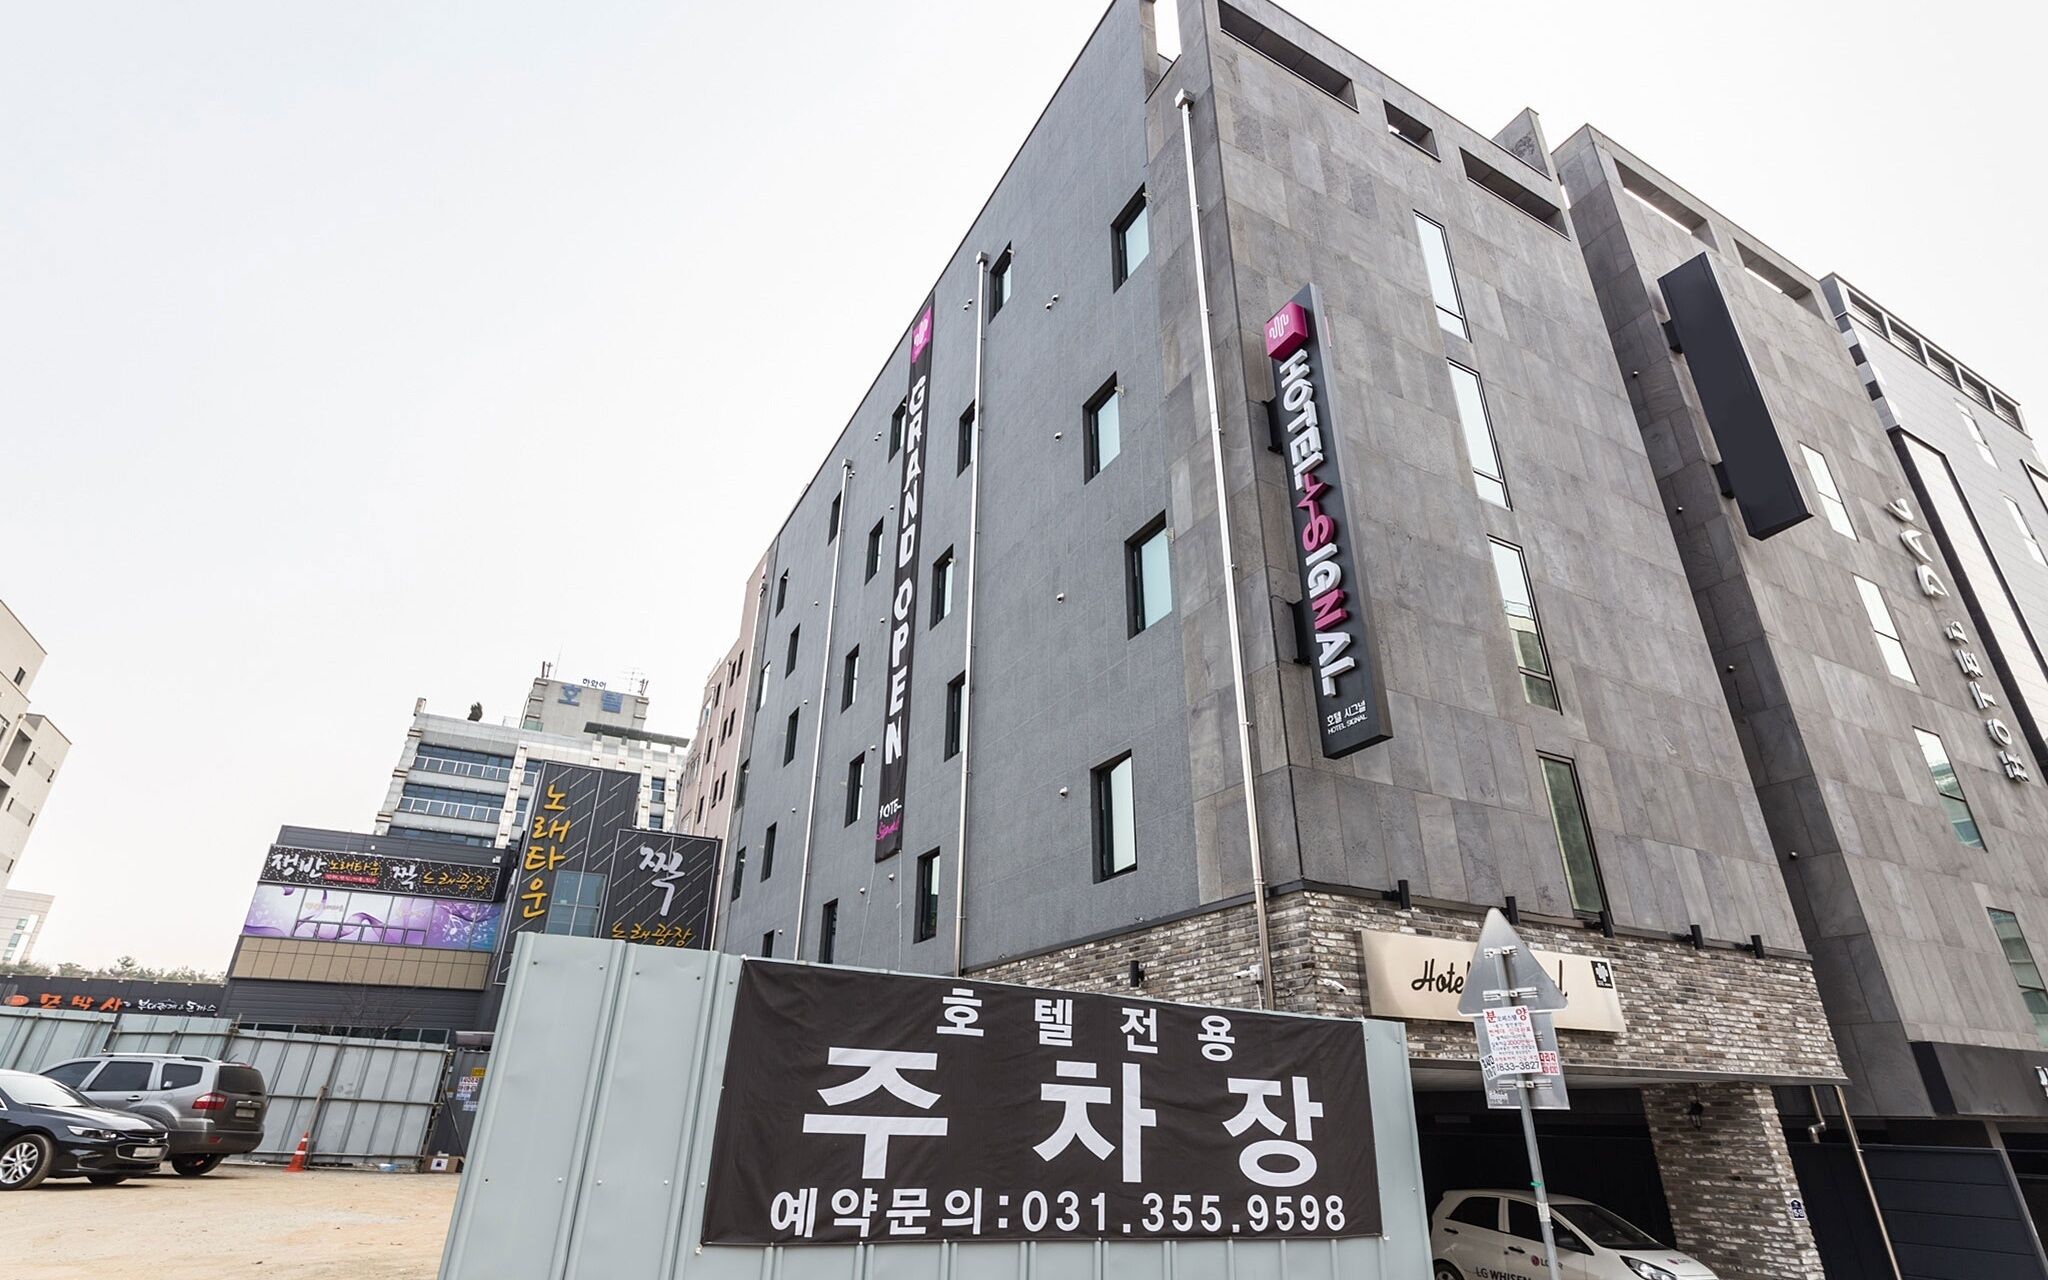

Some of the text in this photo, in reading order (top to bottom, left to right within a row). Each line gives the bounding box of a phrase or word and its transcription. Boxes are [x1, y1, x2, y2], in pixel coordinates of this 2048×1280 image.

[885, 381, 926, 766] GRAND OPEN
[1278, 349, 1355, 698] HOTEL SIGNAL
[1945, 620, 2031, 783] HOTEL
[329, 860, 380, 876] 노래타운
[521, 784, 571, 919] 노래타운
[612, 922, 693, 947] 노래광장
[803, 1046, 1323, 1188] 주차장
[1475, 1266, 1488, 1279] LG
